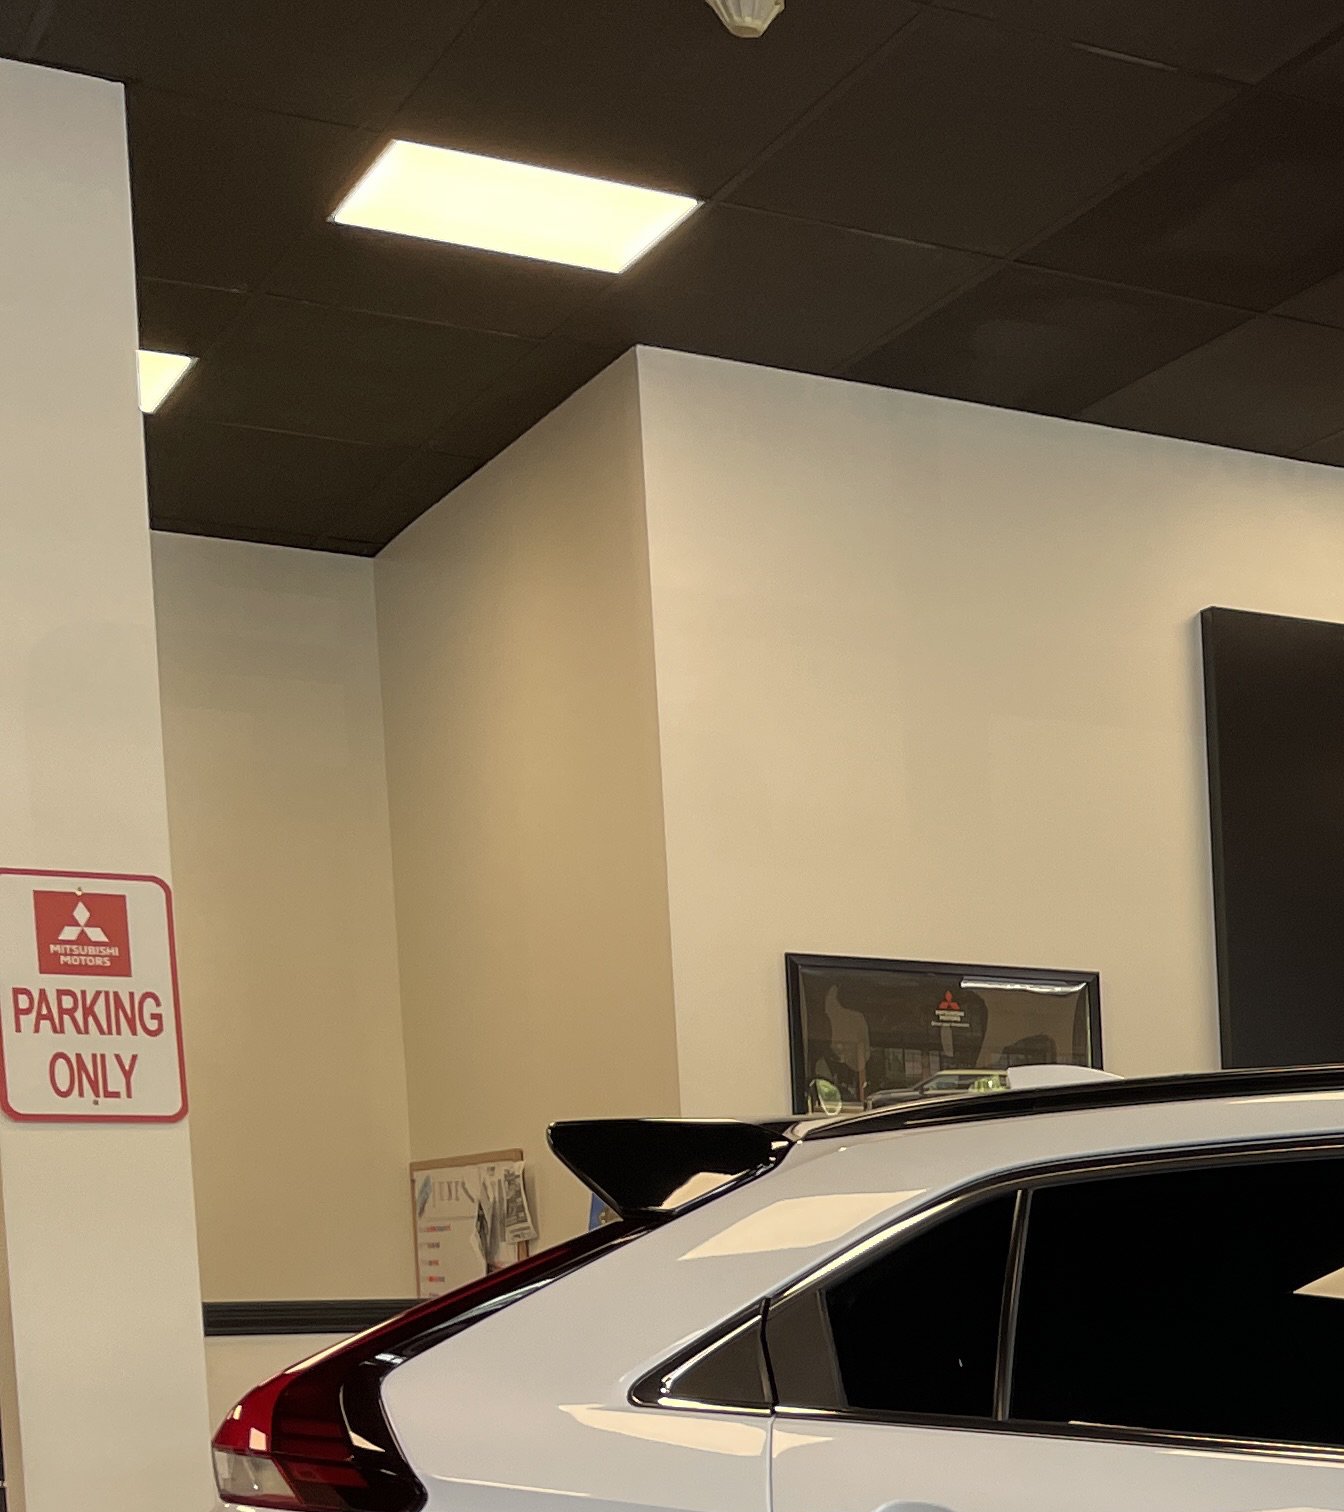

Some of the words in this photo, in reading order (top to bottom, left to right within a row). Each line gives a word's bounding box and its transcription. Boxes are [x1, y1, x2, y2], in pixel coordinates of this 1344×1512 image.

[49, 943, 120, 957] MITSUBISHI
[59, 955, 111, 967] MOTORS
[11, 987, 164, 1038] PARKING
[48, 1051, 138, 1100] ONLY
